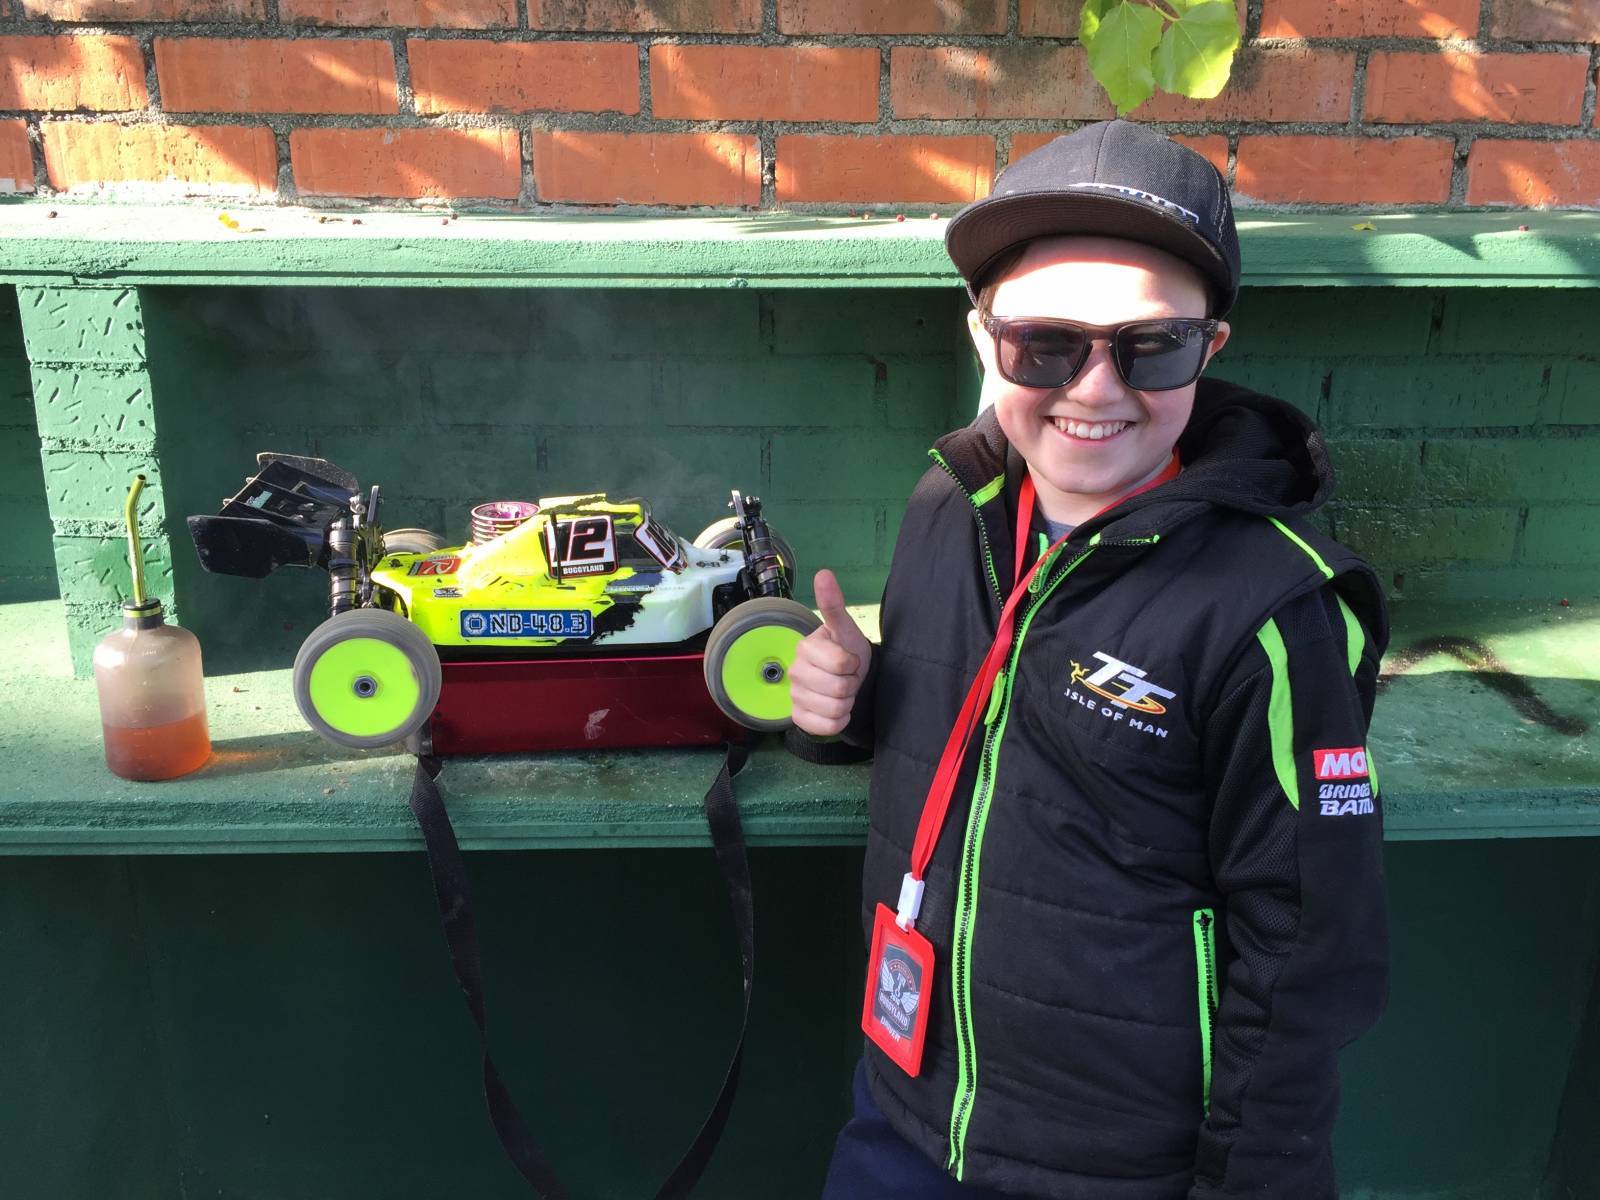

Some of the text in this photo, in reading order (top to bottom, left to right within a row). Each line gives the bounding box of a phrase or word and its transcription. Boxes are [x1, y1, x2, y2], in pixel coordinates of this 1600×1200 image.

[562, 564, 605, 575] BUGGYLAND
[1063, 687, 1169, 739] ISLE OF MAN
